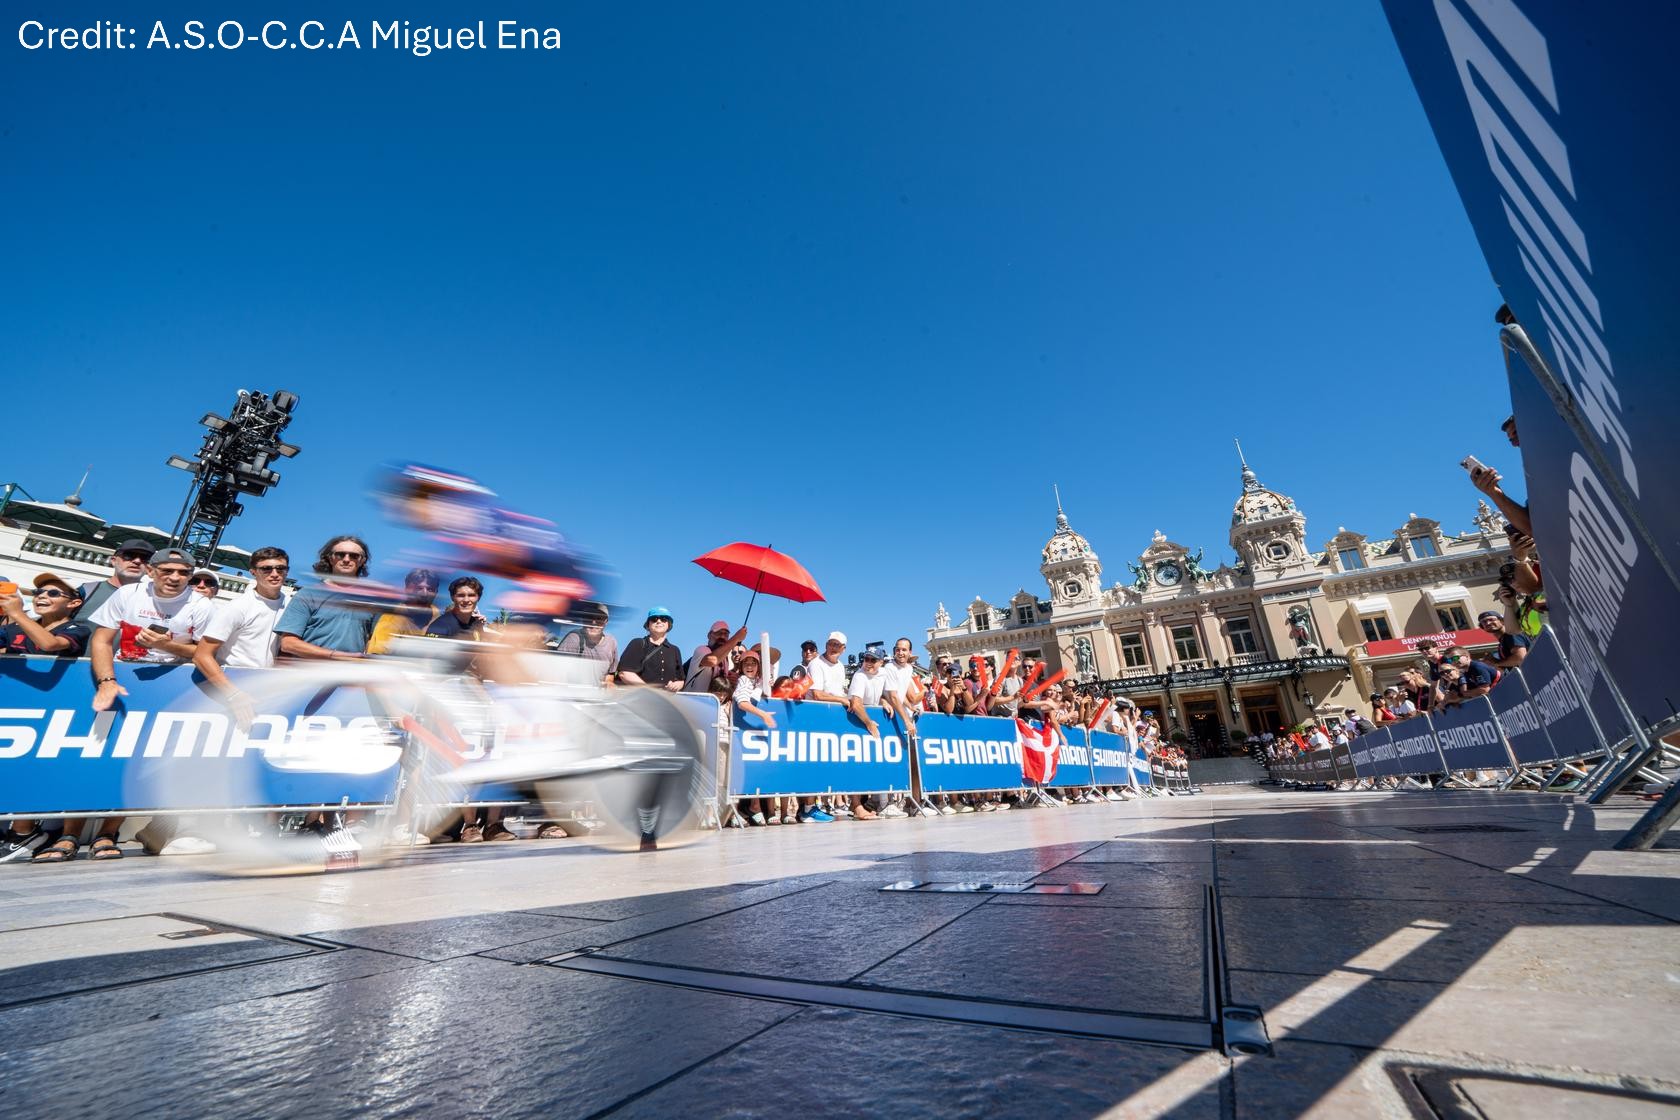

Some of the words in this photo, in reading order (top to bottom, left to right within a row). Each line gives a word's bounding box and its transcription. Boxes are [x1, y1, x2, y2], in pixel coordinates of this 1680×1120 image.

[1534, 670, 1580, 727] SHIMANO
[742, 731, 903, 762] SHIMANO
[1395, 734, 1436, 758] SHIMANO
[1438, 721, 1499, 750] SHIMANO
